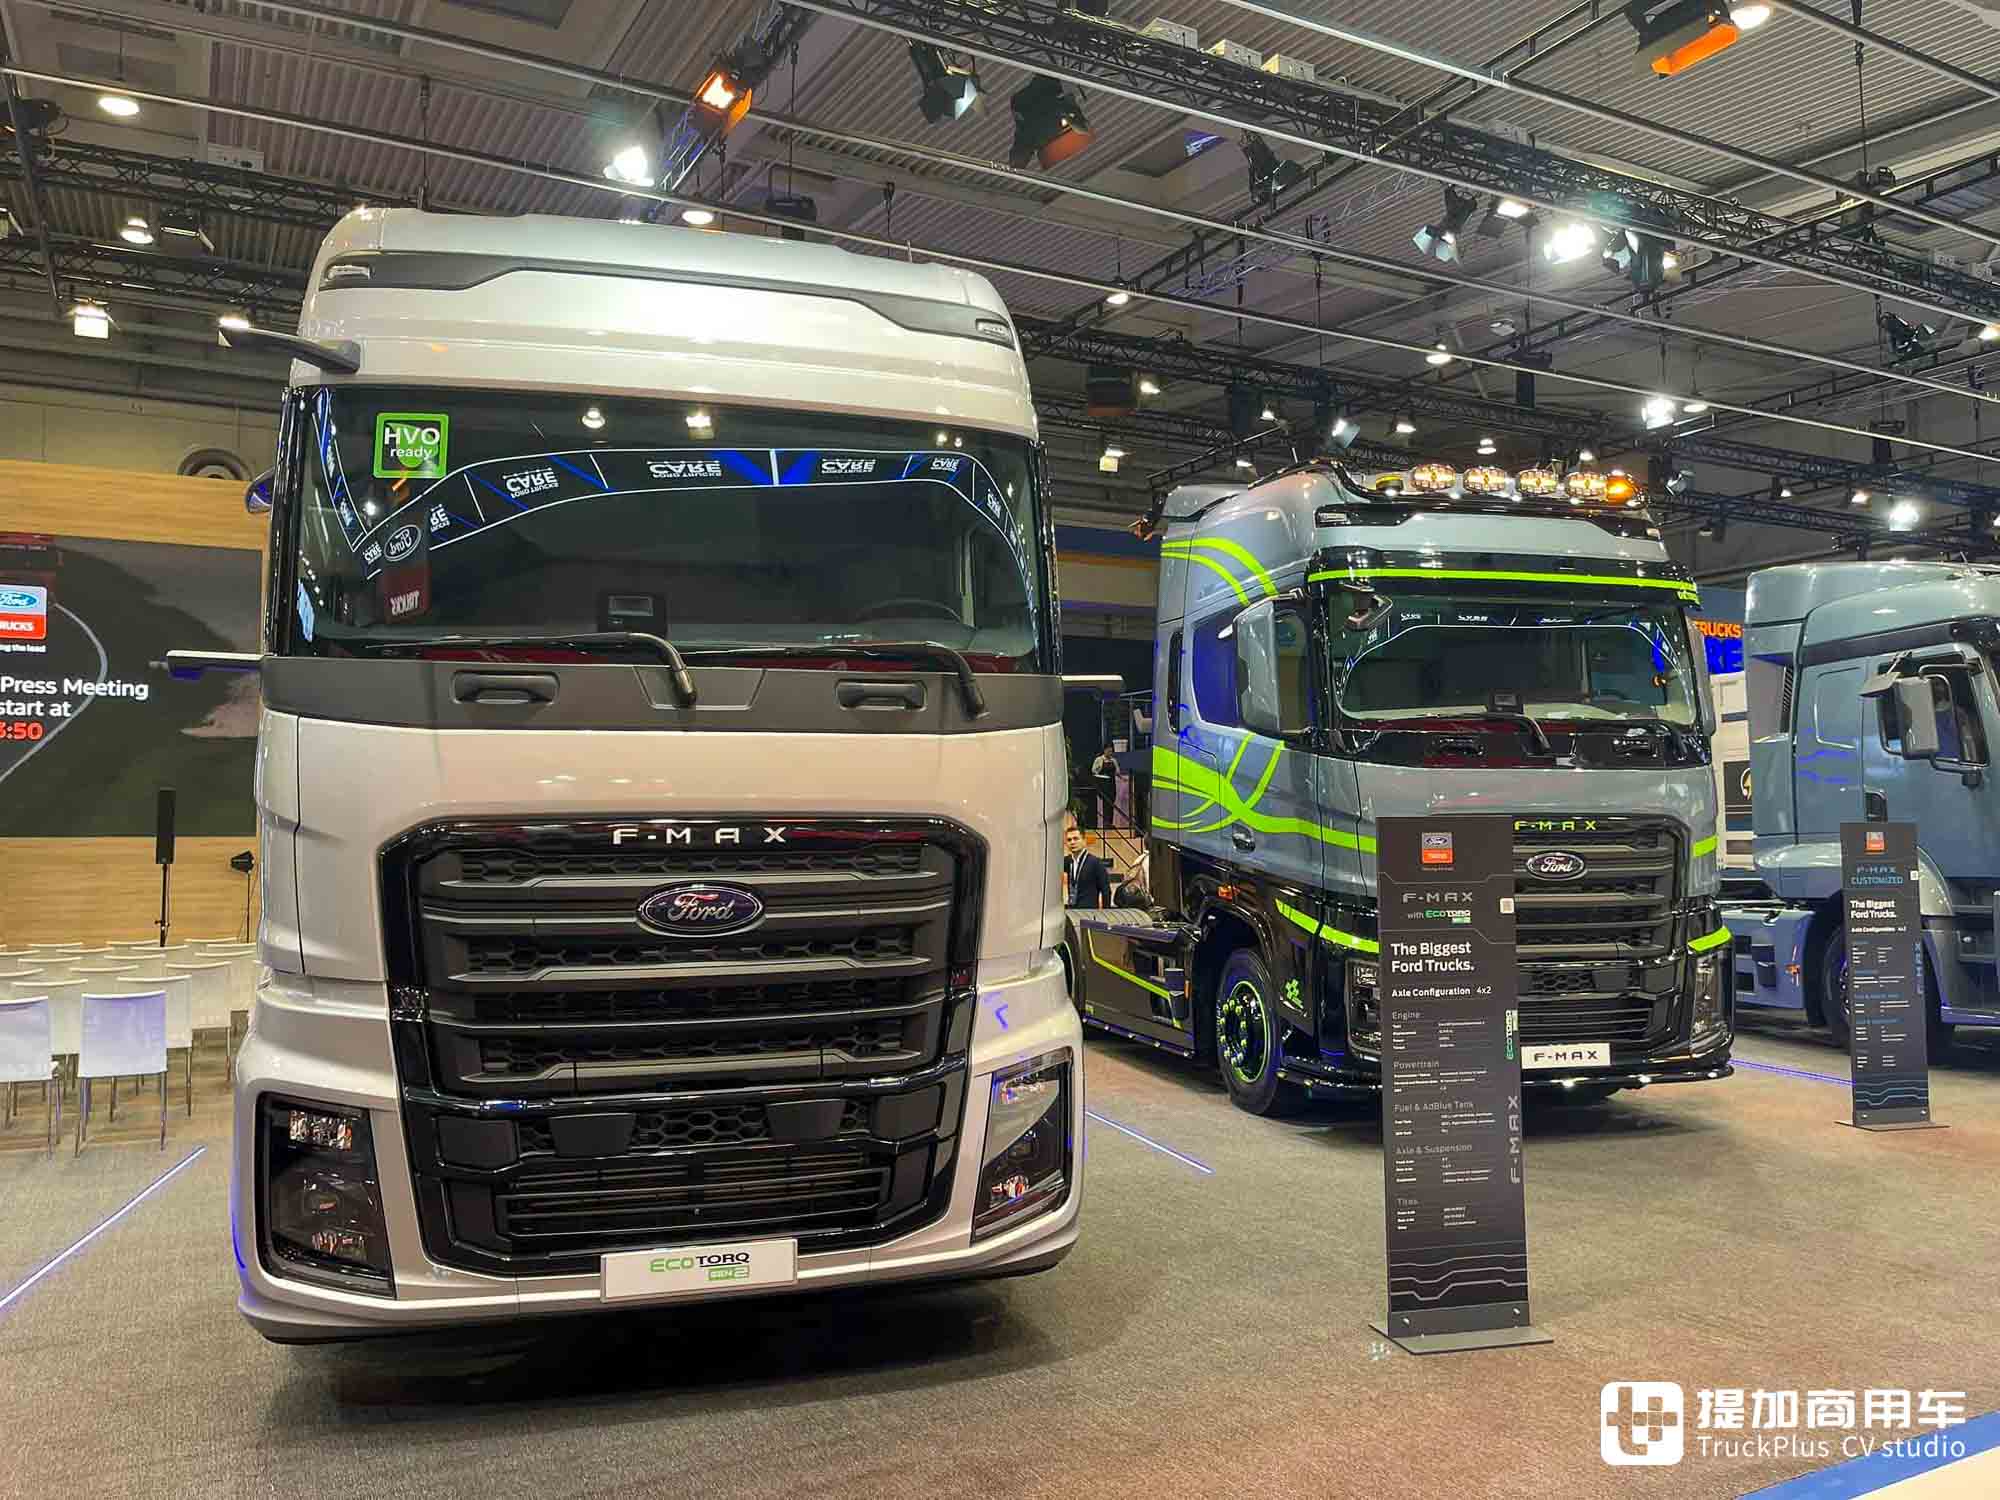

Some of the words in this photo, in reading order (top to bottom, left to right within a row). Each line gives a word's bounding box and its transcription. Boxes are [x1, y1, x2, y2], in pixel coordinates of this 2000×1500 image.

[384, 427, 440, 445] HVO
[390, 446, 432, 461] ready
[0, 620, 34, 631] RUCKS
[1704, 637, 1744, 674] RE
[0, 676, 58, 695] Press
[63, 678, 149, 700] Meeting
[0, 700, 45, 717] start
[49, 701, 72, 717] at
[1514, 820, 1597, 831] F-MAX
[612, 827, 787, 845] F-MAX
[1540, 856, 1574, 873] Ford
[1402, 891, 1473, 903] F-MAX
[1850, 900, 1865, 908] The
[667, 892, 736, 921] Ford
[1850, 910, 1868, 918] Ford
[1407, 911, 1424, 919] with
[1391, 943, 1418, 957] The
[1420, 942, 1472, 958] Biggest
[1391, 959, 1423, 973] Ford
[1425, 958, 1475, 972] Trucks.
[1392, 988, 1411, 997] Axle
[1412, 986, 1471, 998] Configuration
[1476, 985, 1492, 994] 4x2
[1392, 1011, 1420, 1021] Engine
[1533, 1050, 1599, 1062] F-MAX
[1508, 1095, 1521, 1184] F-MAX
